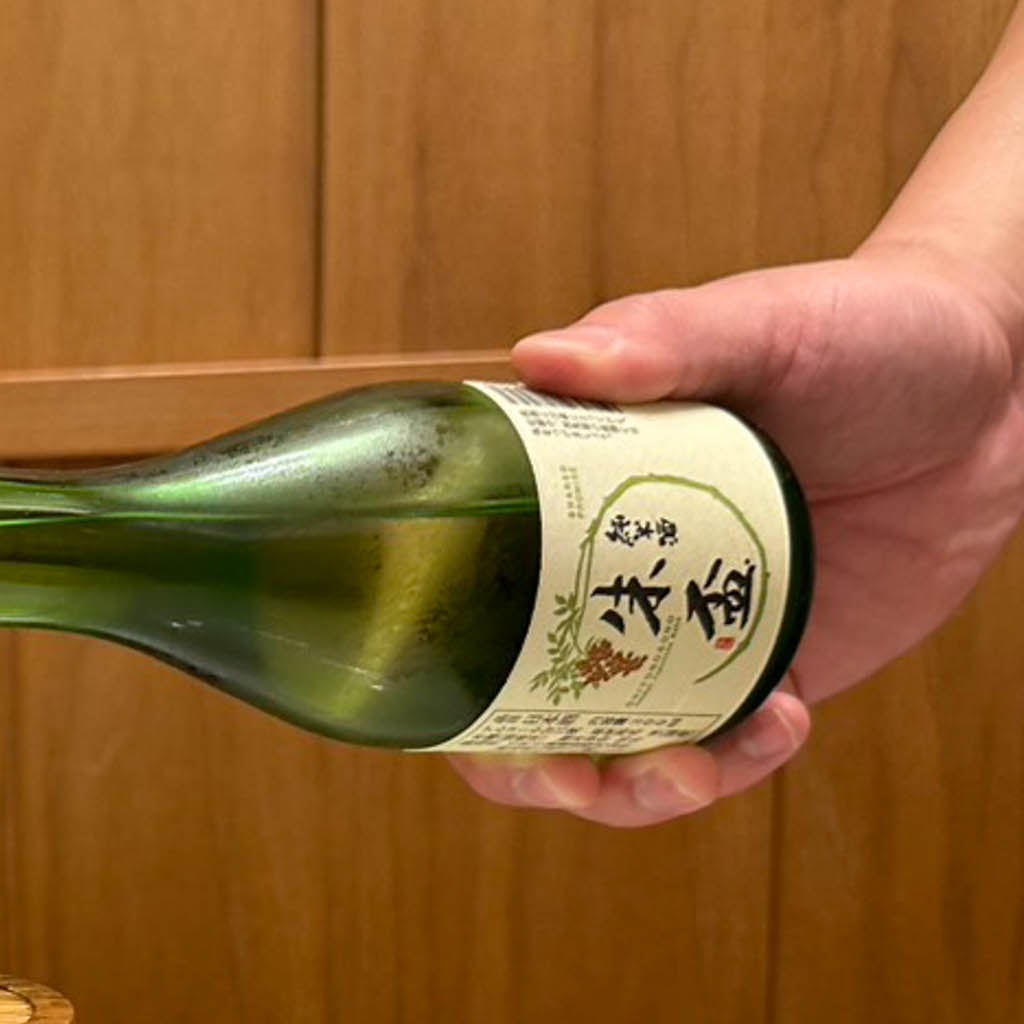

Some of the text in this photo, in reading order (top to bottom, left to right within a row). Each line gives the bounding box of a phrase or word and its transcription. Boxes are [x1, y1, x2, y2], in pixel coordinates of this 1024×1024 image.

[605, 514, 679, 548] 純米酒
[590, 557, 756, 641] 朱盃
